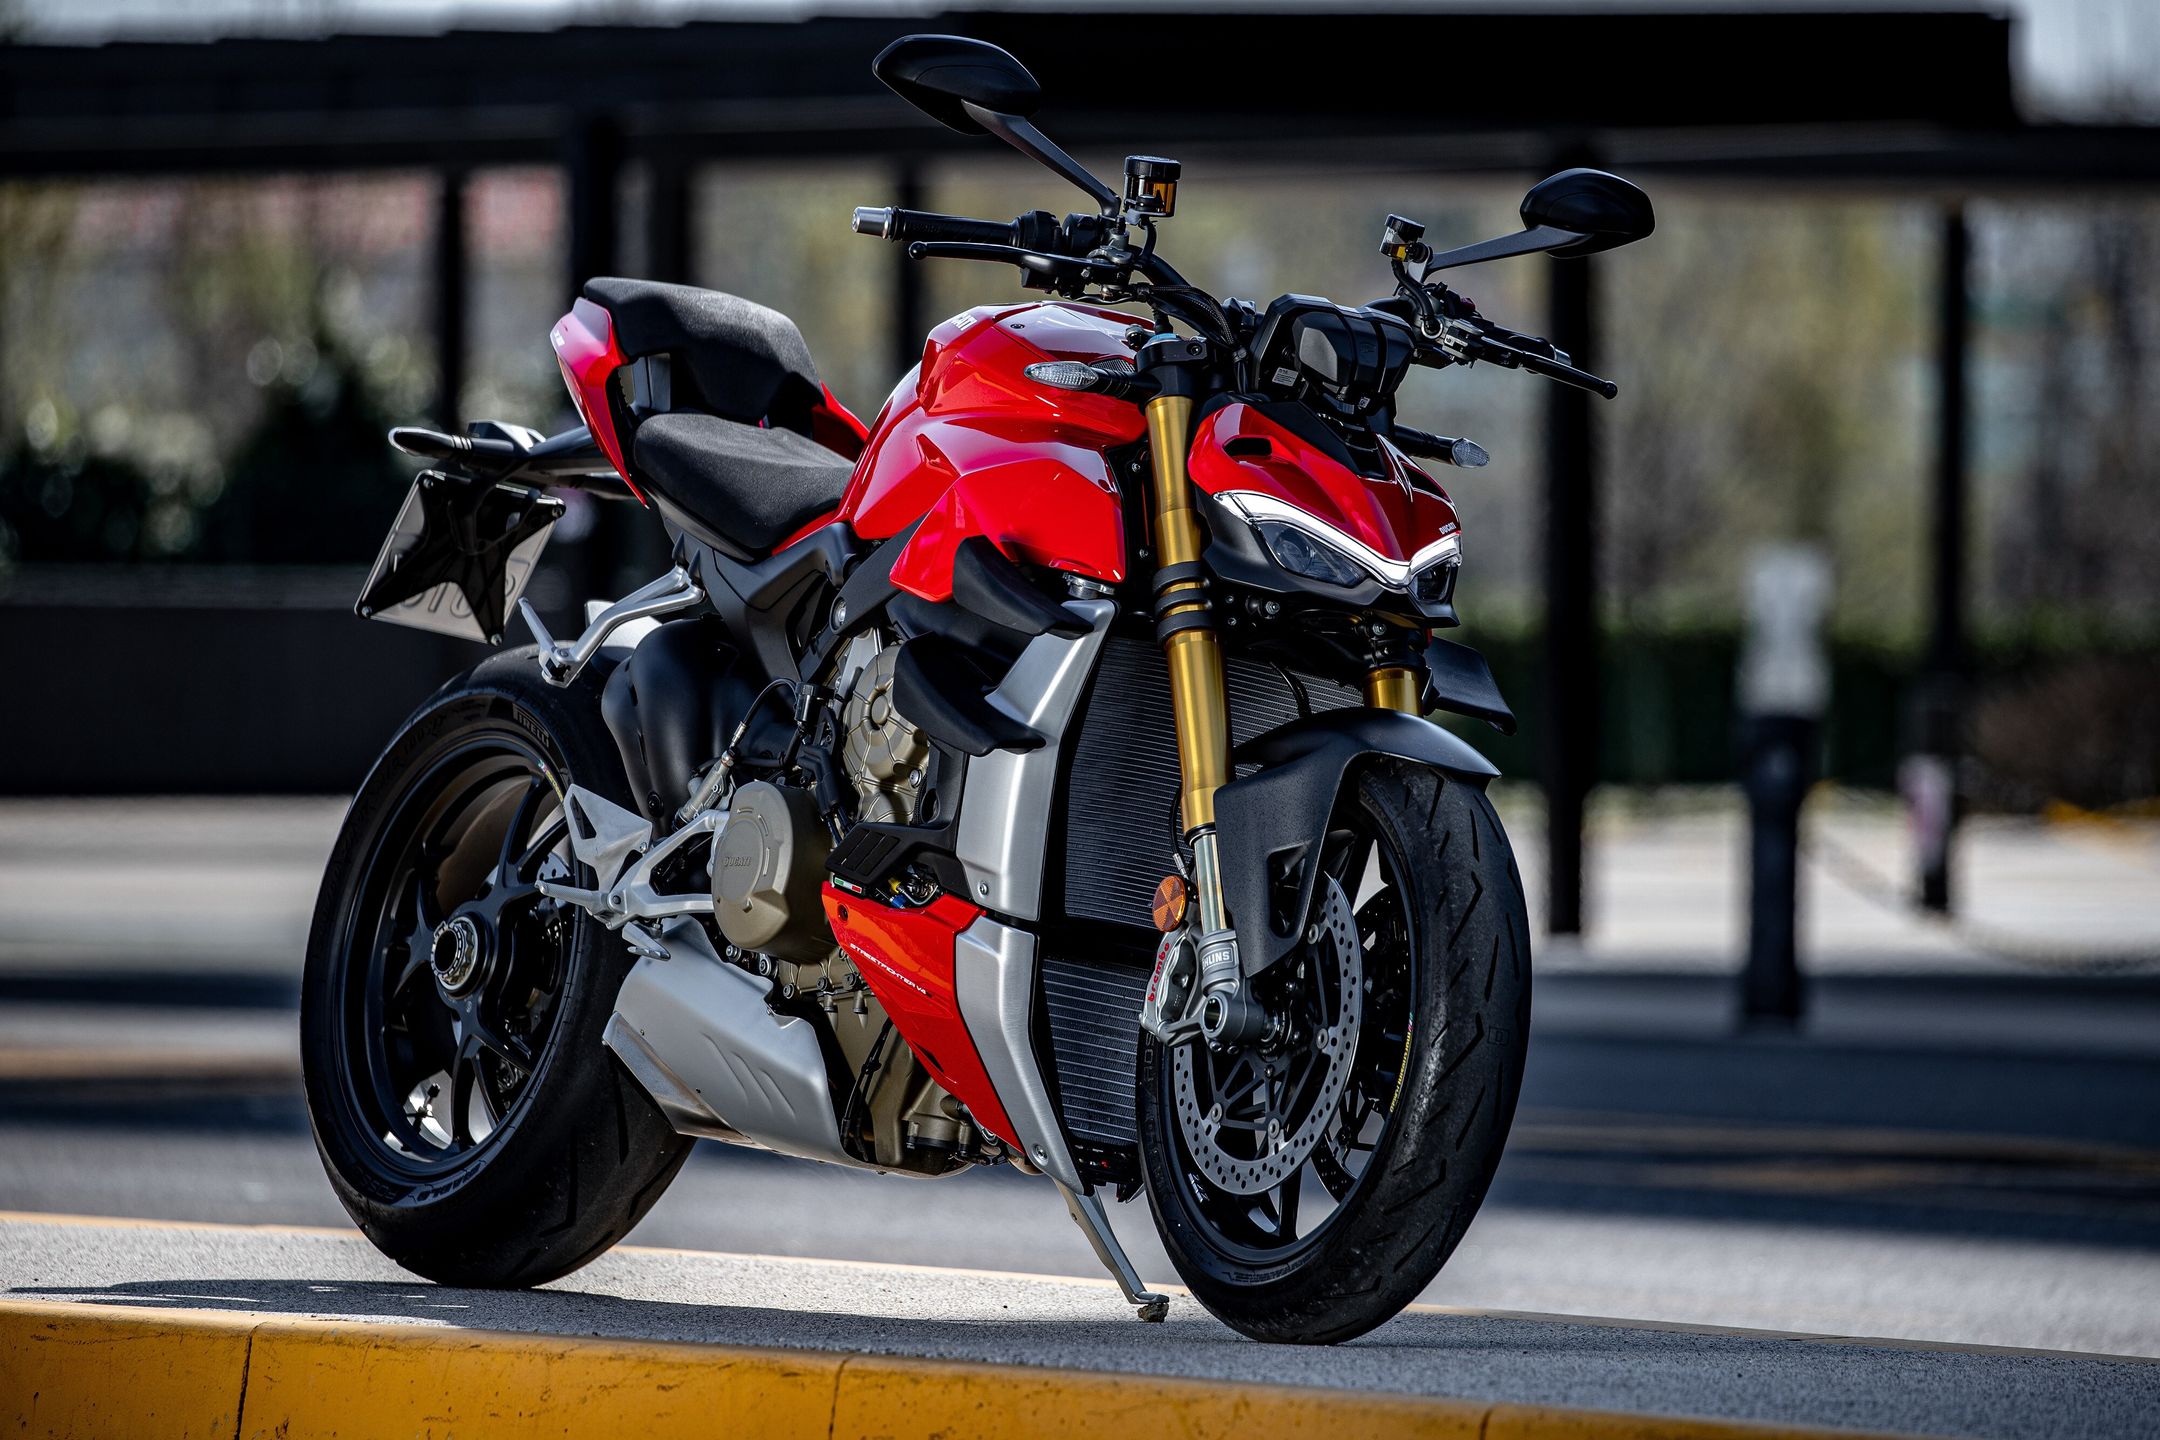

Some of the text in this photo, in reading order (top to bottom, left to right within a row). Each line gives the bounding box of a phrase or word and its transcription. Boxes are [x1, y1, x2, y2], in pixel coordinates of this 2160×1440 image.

[511, 702, 549, 749] PIRELLI
[723, 856, 752, 867] DUCATI
[850, 942, 917, 988] STREETFIGHTER
[1147, 942, 1170, 1002] brembo
